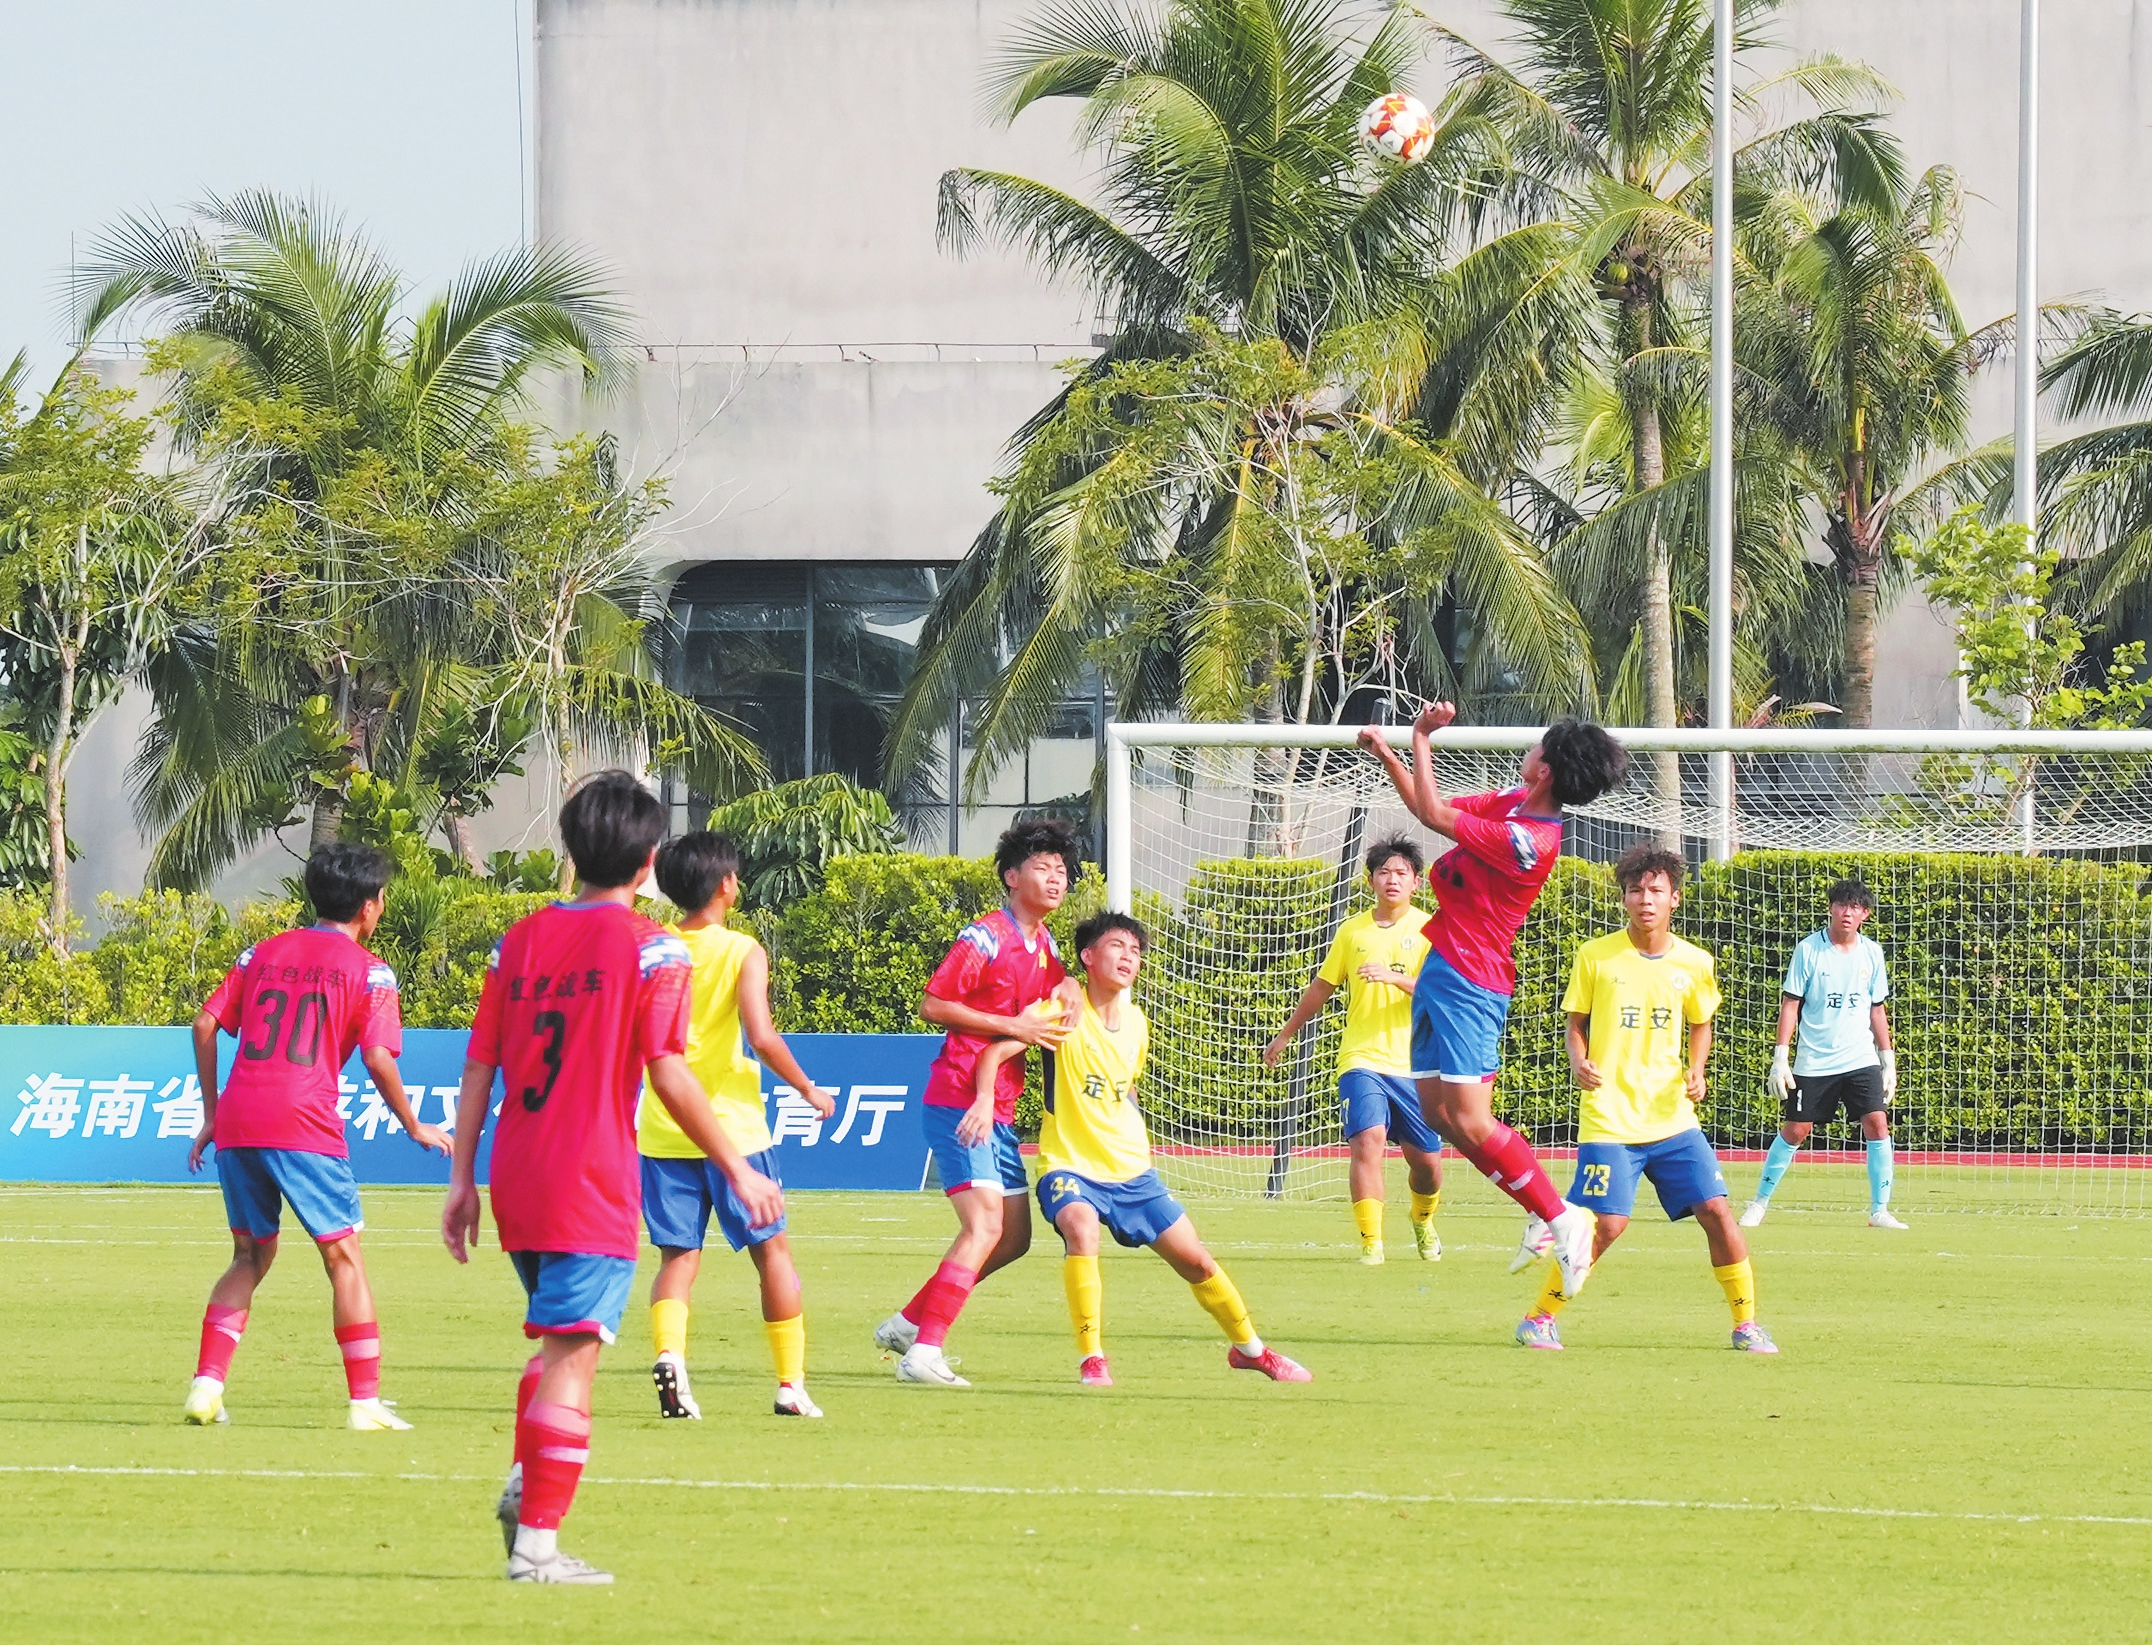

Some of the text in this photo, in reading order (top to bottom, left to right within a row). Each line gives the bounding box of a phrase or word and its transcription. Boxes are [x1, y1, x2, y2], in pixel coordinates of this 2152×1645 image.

[1827, 992, 1861, 1009] 定安
[244, 989, 328, 1067] 30
[1619, 1006, 1672, 1030] 定安
[522, 1010, 565, 1112] 3
[1051, 1176, 1080, 1203] 34
[1583, 1164, 1611, 1196] 23
